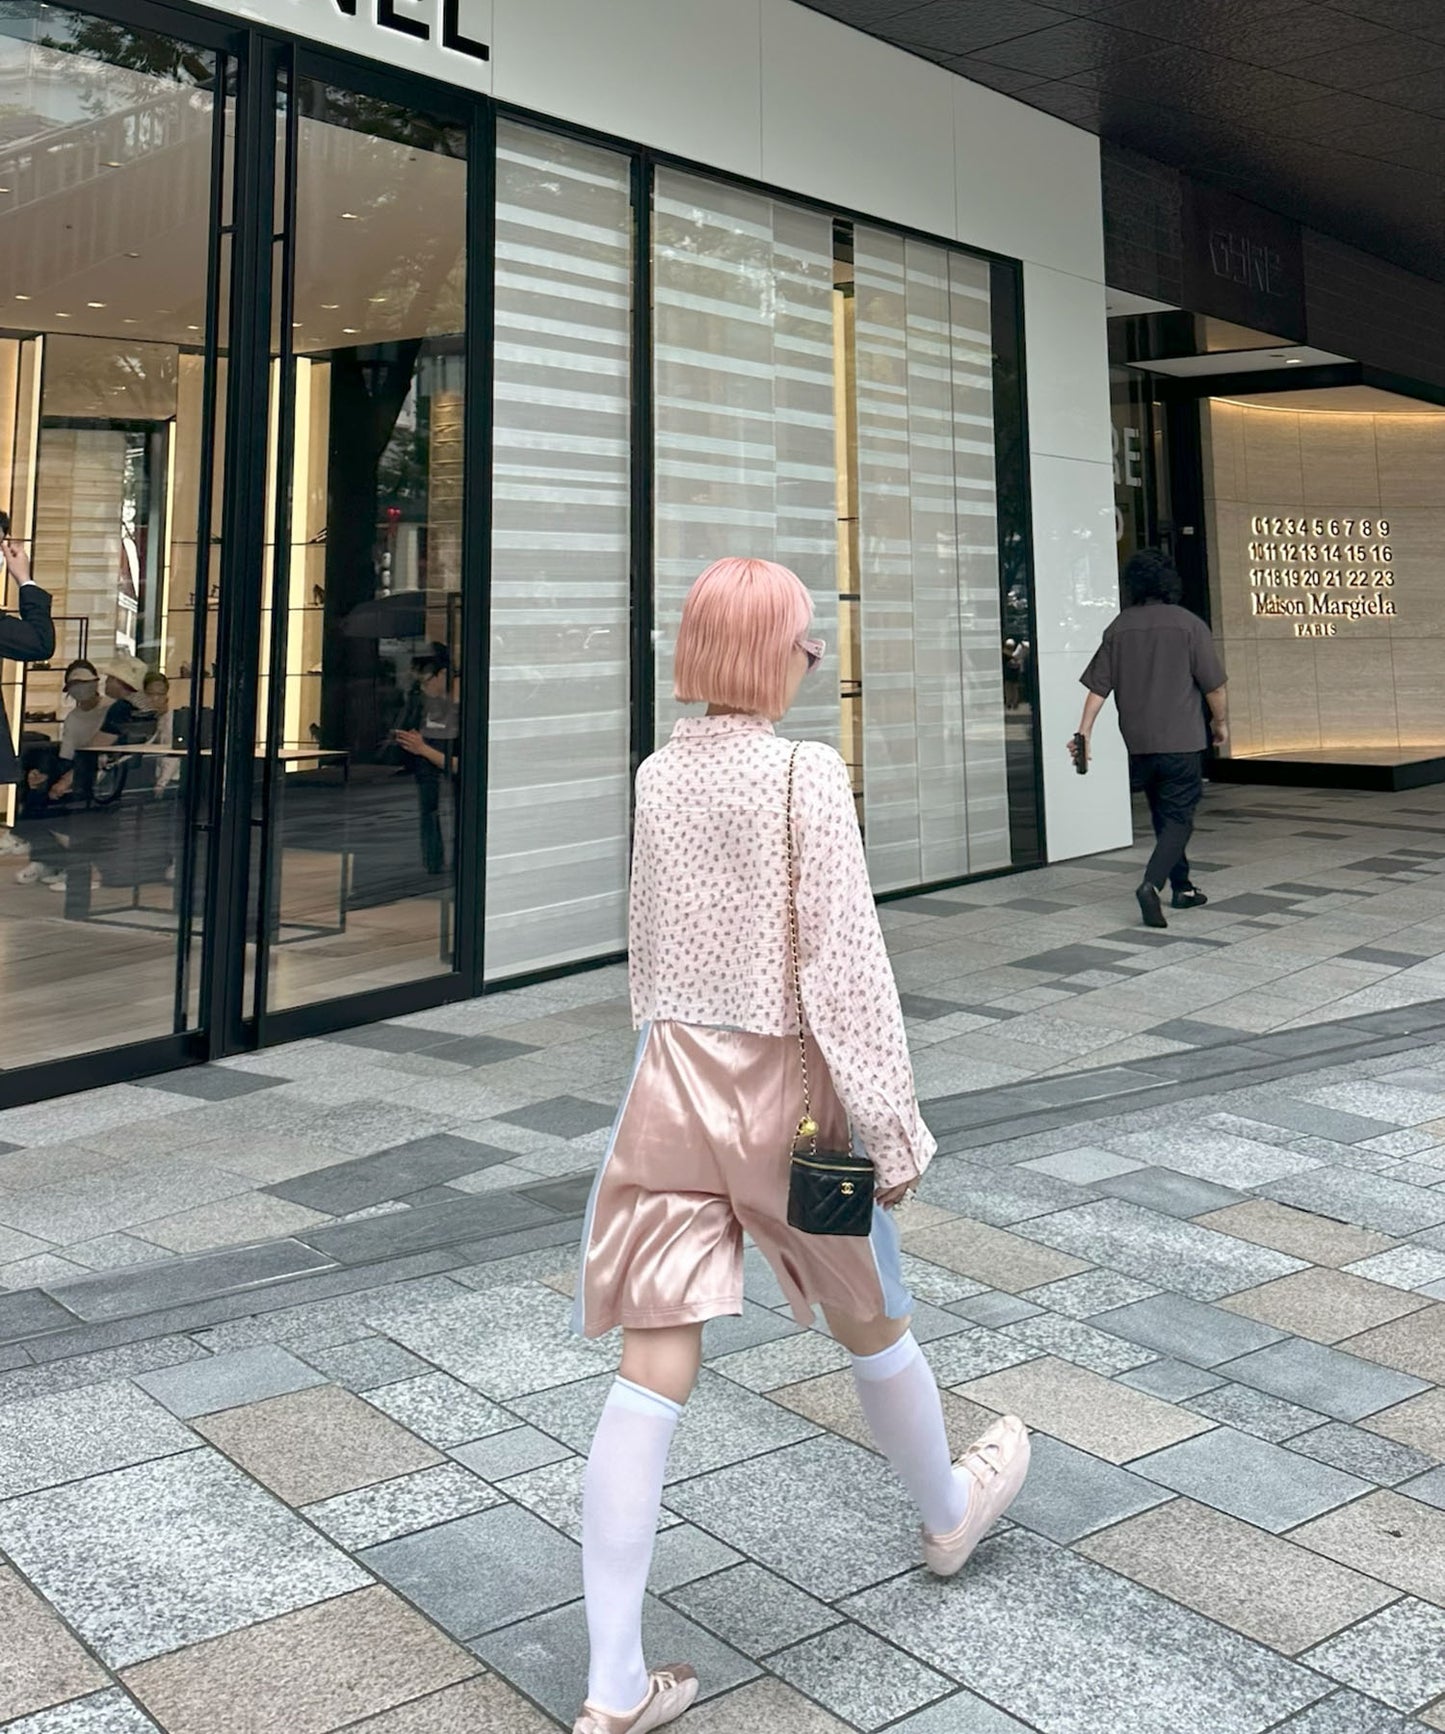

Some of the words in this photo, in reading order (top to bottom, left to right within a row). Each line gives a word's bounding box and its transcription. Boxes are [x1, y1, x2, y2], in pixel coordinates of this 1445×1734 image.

[1252, 517, 1262, 534] 0
[1263, 517, 1269, 535] 1
[1272, 518, 1283, 535] 2
[1285, 518, 1296, 536] 3
[1297, 518, 1308, 536] 4
[1313, 519, 1323, 536] 5
[1329, 519, 1340, 537] 6
[1343, 520, 1354, 537] 7
[1360, 520, 1372, 537] 8
[1378, 520, 1390, 537] 9
[1249, 542, 1263, 560] 10
[1263, 544, 1277, 560] 11
[1280, 544, 1298, 561] 12
[1300, 544, 1318, 561] 13
[1321, 545, 1342, 562] 14
[1345, 545, 1366, 562] 15
[1370, 545, 1392, 562] 16
[1250, 569, 1264, 586] 17
[1264, 570, 1281, 586] 18
[1283, 570, 1299, 587] 19
[1301, 571, 1320, 587] 20
[1323, 571, 1342, 587] 21
[1347, 571, 1368, 587] 22
[1372, 571, 1394, 587] 23
[1252, 592, 1306, 616] Maison
[1308, 593, 1396, 621] Margiela
[1295, 623, 1337, 637] PARIS
